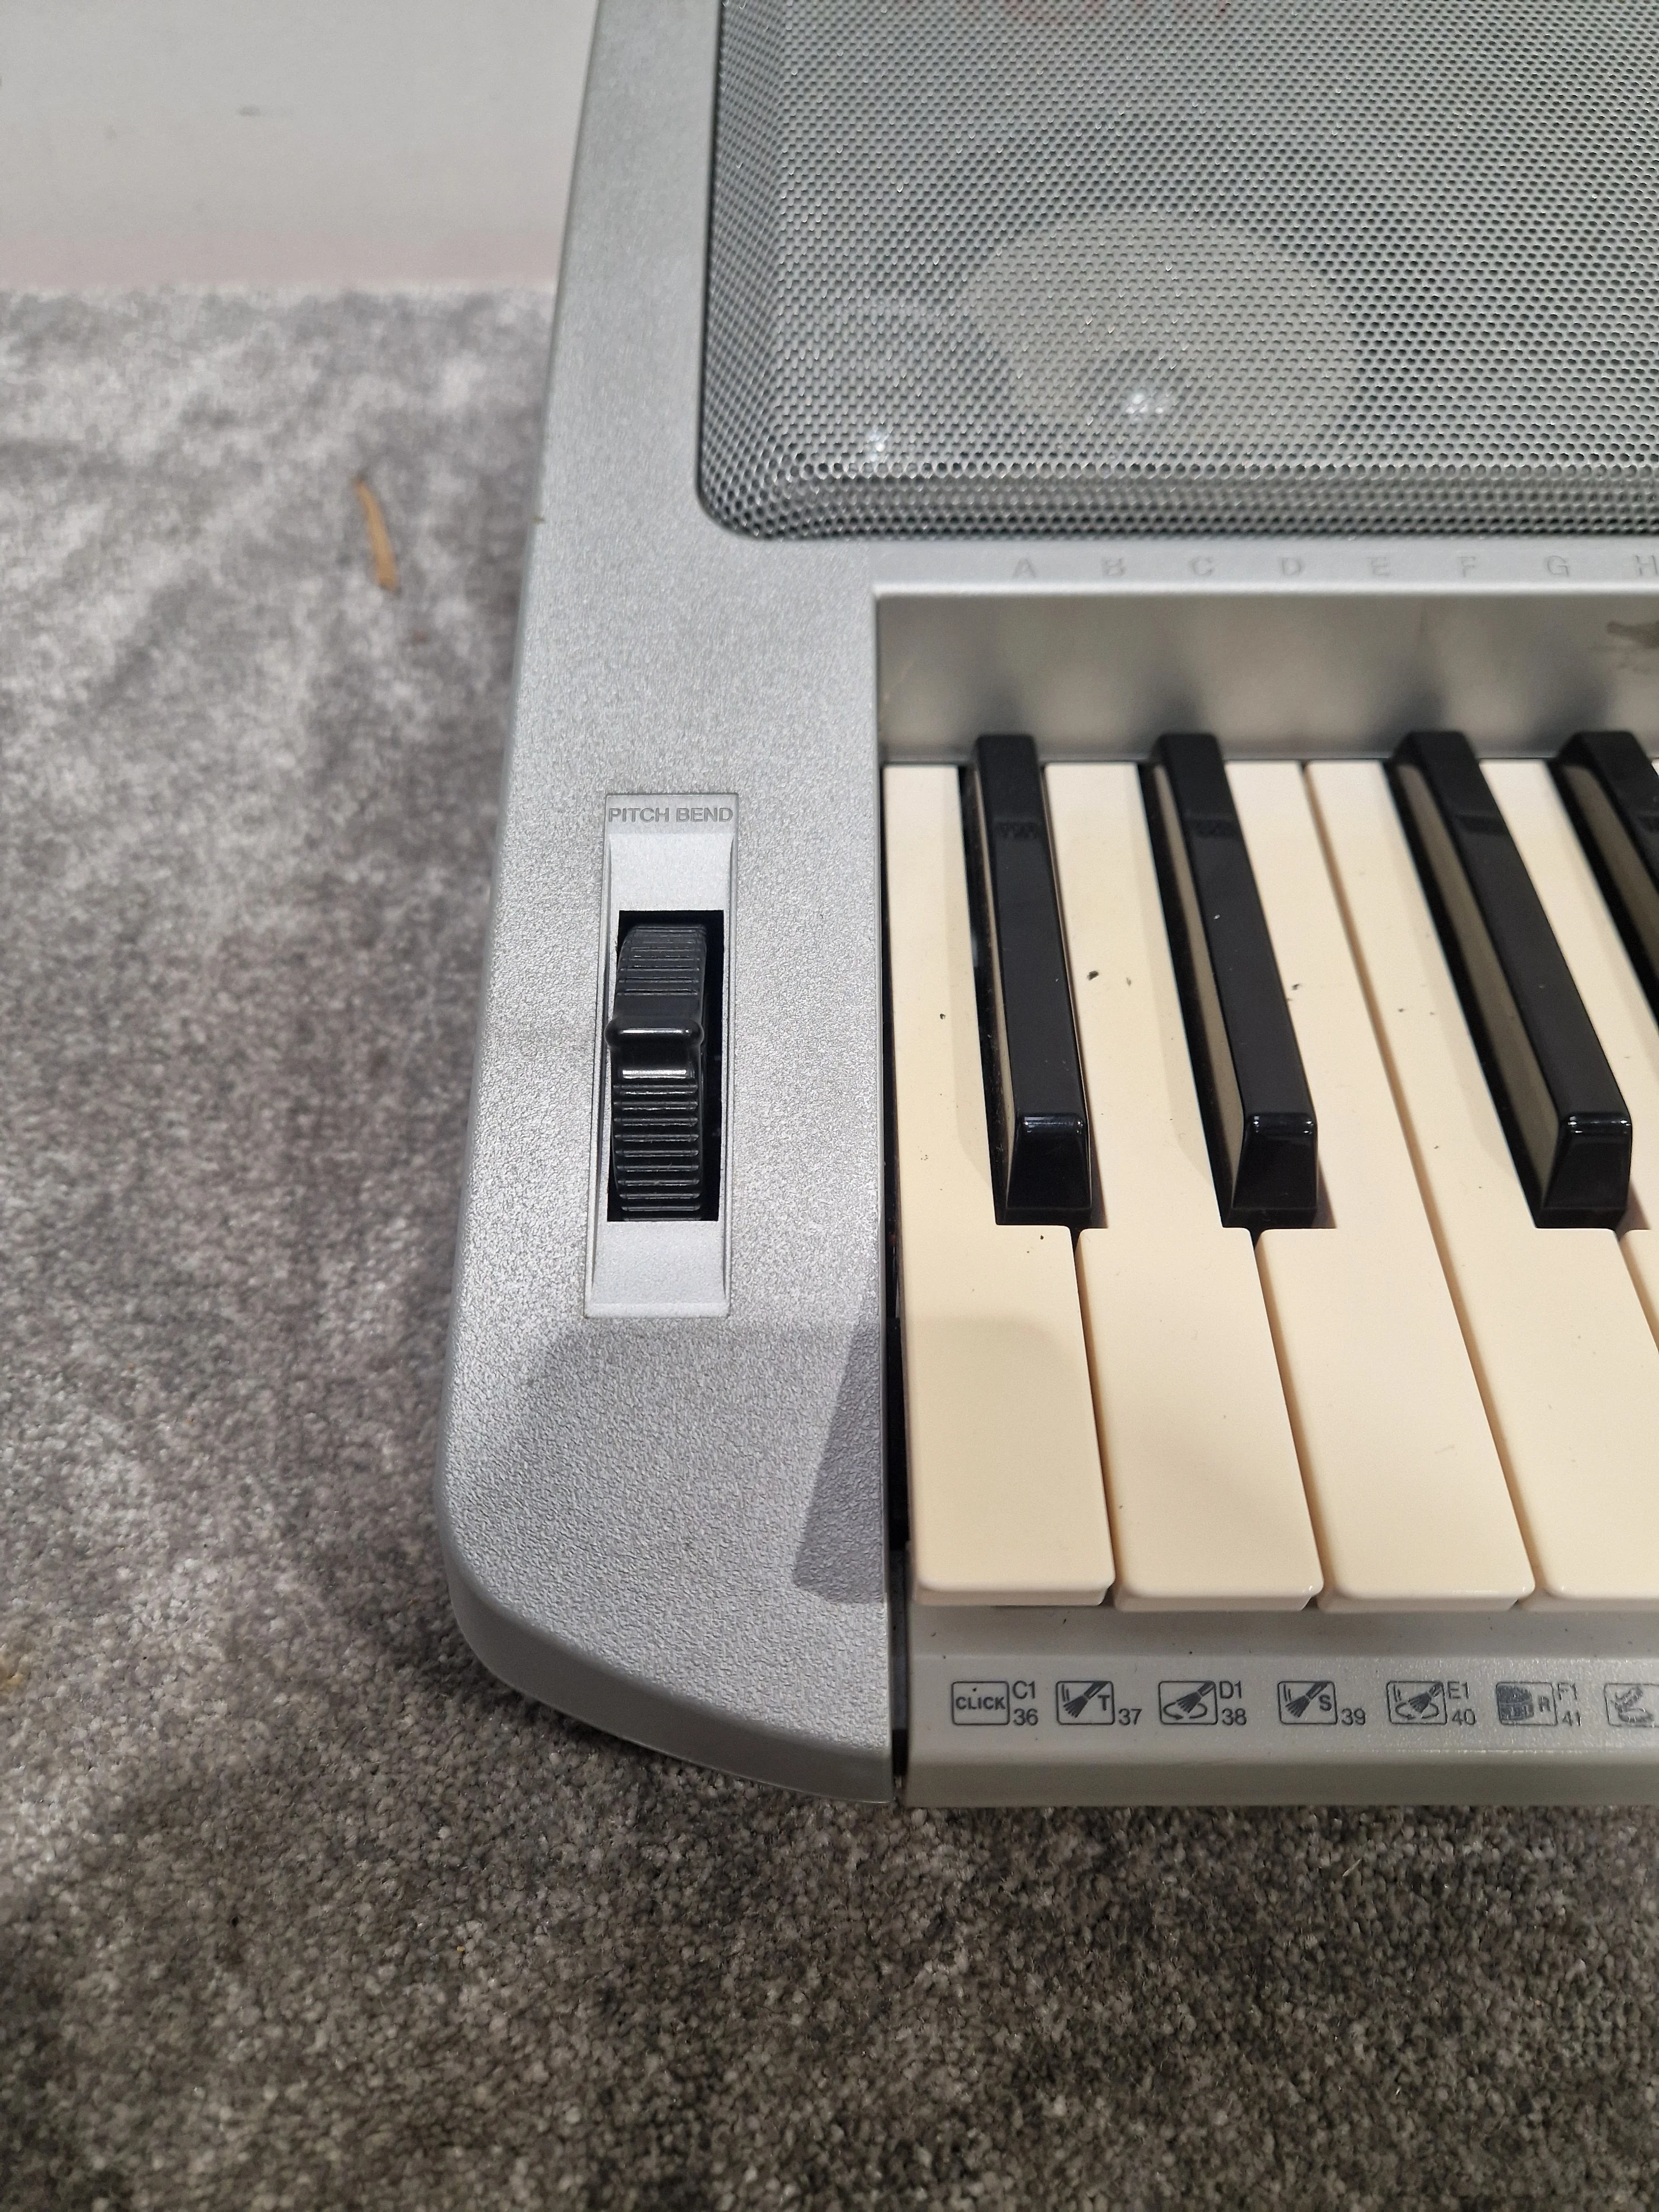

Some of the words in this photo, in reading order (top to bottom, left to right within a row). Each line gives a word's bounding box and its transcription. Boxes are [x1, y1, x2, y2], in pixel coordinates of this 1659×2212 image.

[1013, 557, 1037, 578] A
[1191, 556, 1214, 576] C
[1368, 556, 1390, 577] E
[1458, 556, 1477, 577] F
[1547, 556, 1569, 577] G
[608, 807, 670, 822] PITCH
[676, 807, 733, 822] BEND
[1013, 1681, 1036, 1699] C1
[1219, 1681, 1243, 1699] D1
[1448, 1682, 1469, 1699] E1
[1558, 1682, 1578, 1700] F1
[956, 1697, 1005, 1710] CLICK
[1097, 1694, 1110, 1711] T
[1319, 1695, 1332, 1712] S
[1013, 1709, 1038, 1726] 36
[1118, 1709, 1142, 1725] 37
[1222, 1708, 1246, 1725] 38
[1341, 1708, 1366, 1725] 39
[1452, 1708, 1477, 1725] 40
[1562, 1710, 1582, 1726] 41
